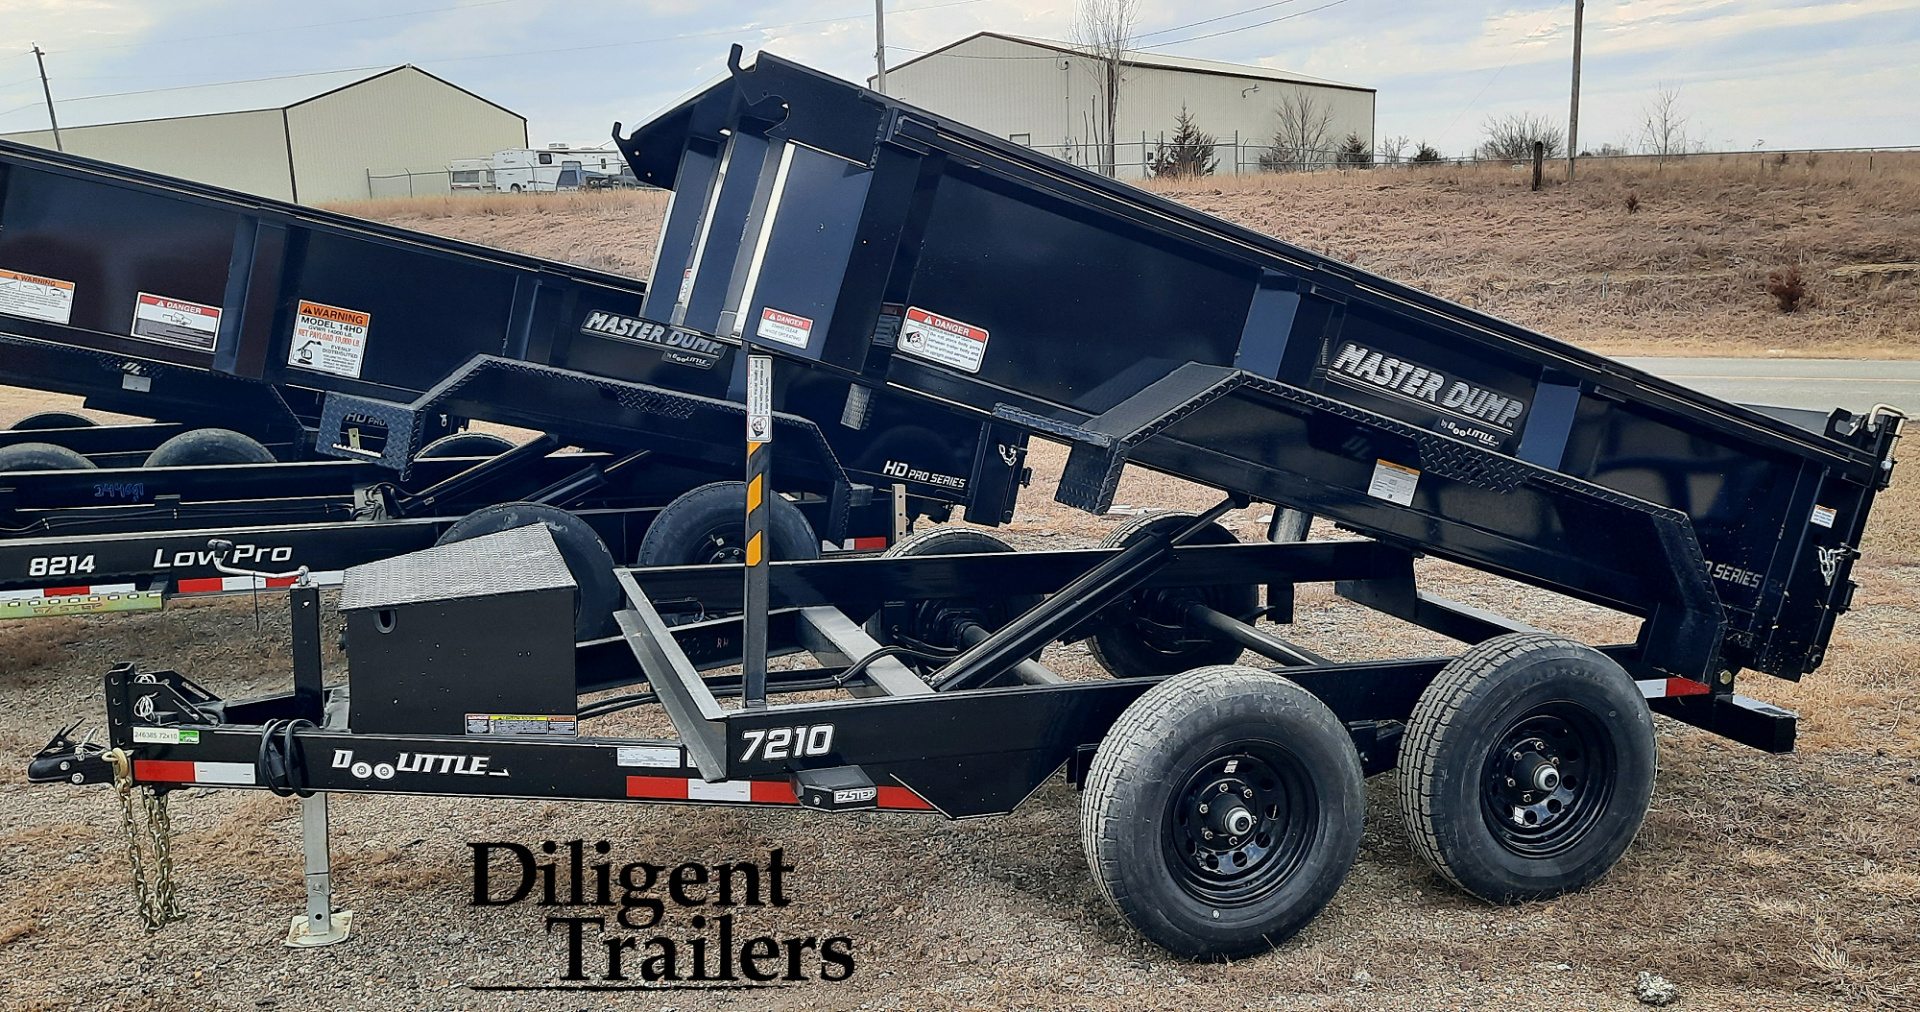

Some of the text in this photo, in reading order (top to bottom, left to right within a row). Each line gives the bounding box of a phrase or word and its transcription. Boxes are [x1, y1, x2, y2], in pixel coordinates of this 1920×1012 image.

[21, 275, 56, 287] WARNING
[166, 301, 202, 315] DANGER
[313, 306, 364, 325] WARNING
[300, 316, 363, 335] MODEL 14HD
[776, 314, 804, 328] DANGER
[934, 318, 970, 337] DANGER
[298, 328, 309, 338] NET
[309, 329, 334, 342] PAYLOAD
[586, 311, 724, 355] MASTER DUMP
[1332, 342, 1446, 402] MASTER
[1441, 380, 1525, 426] DUMP
[1440, 418, 1448, 429] by
[882, 459, 967, 489] HD PRO SERIES
[28, 553, 96, 577] 8214
[1712, 562, 1764, 590] SERIES
[740, 723, 835, 762] 7210
